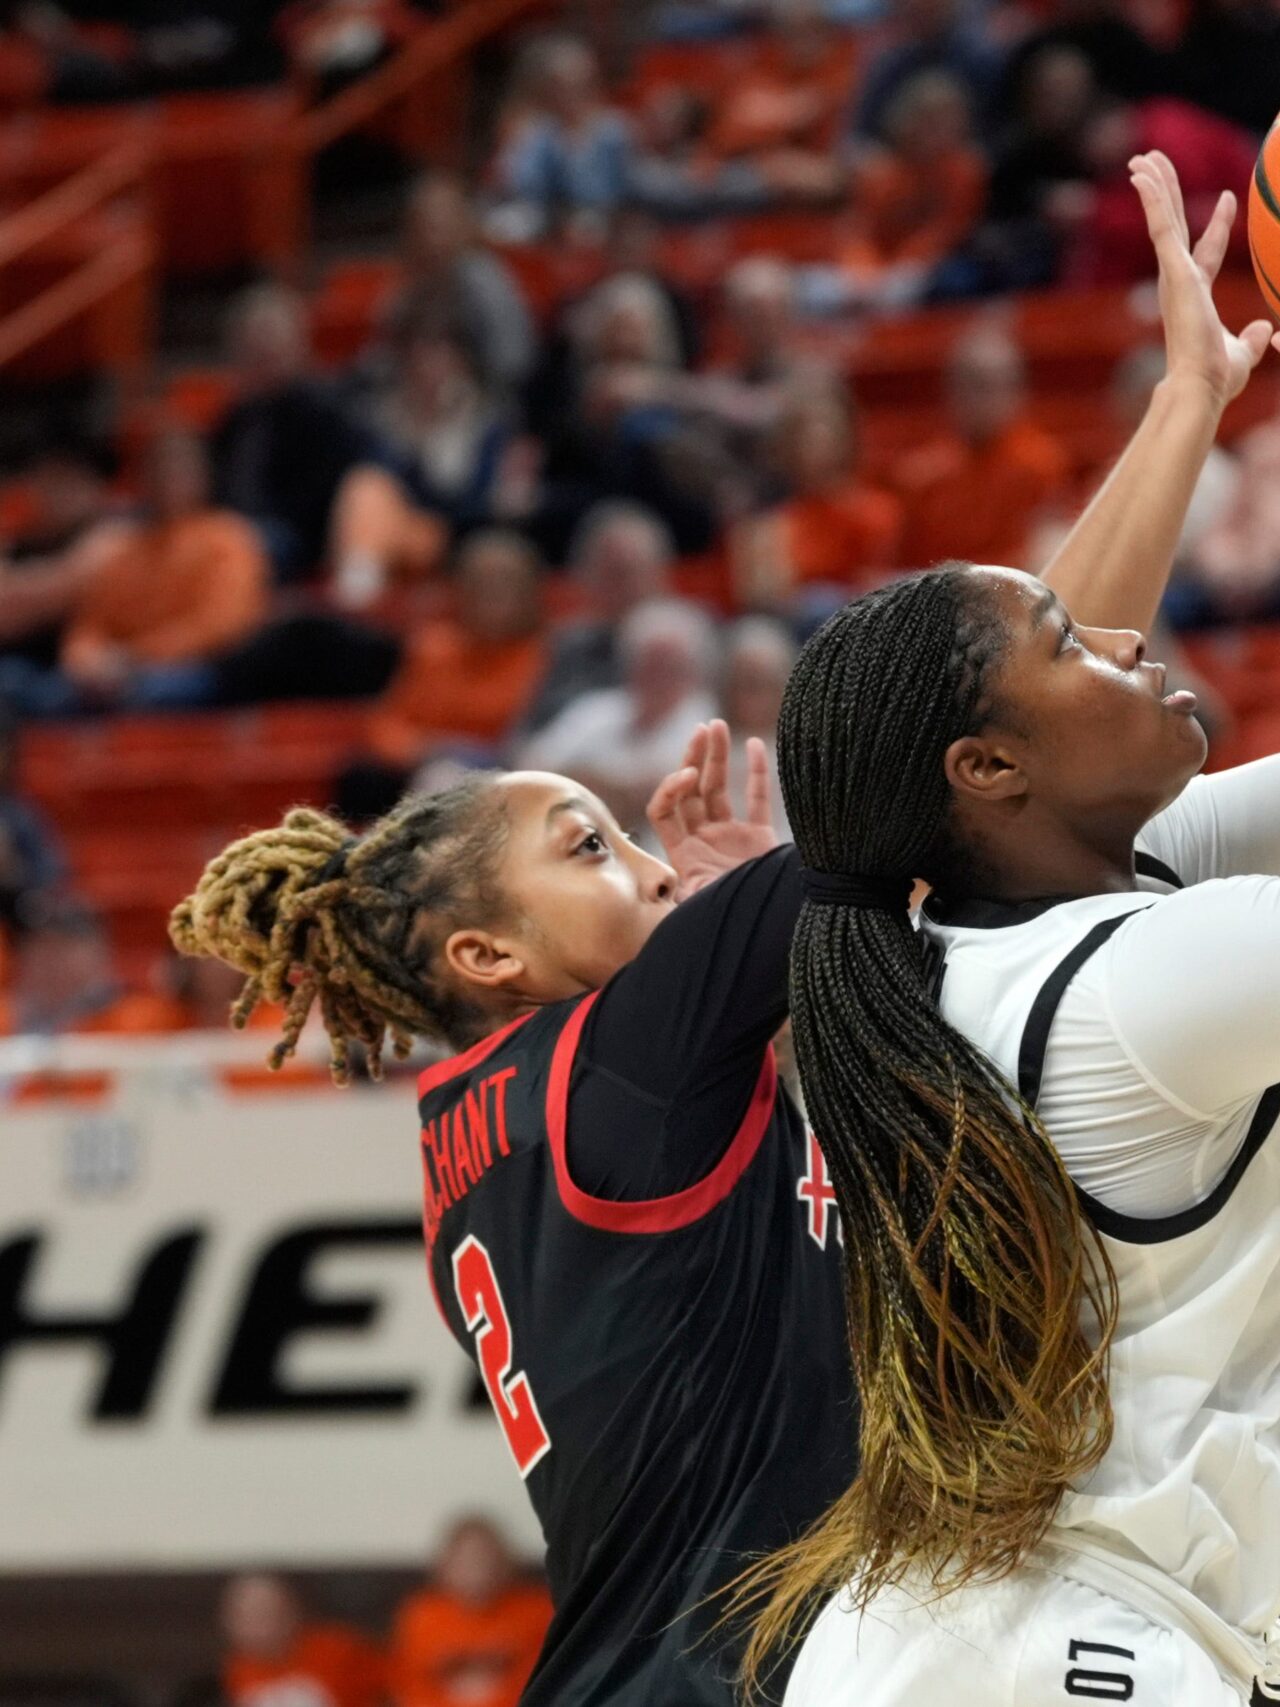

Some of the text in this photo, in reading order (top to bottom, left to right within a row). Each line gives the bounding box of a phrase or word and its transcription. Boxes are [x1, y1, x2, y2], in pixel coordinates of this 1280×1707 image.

[421, 1065, 518, 1247] CHANT
[451, 1233, 552, 1481] 2
[1064, 1638, 1136, 1702] 07
